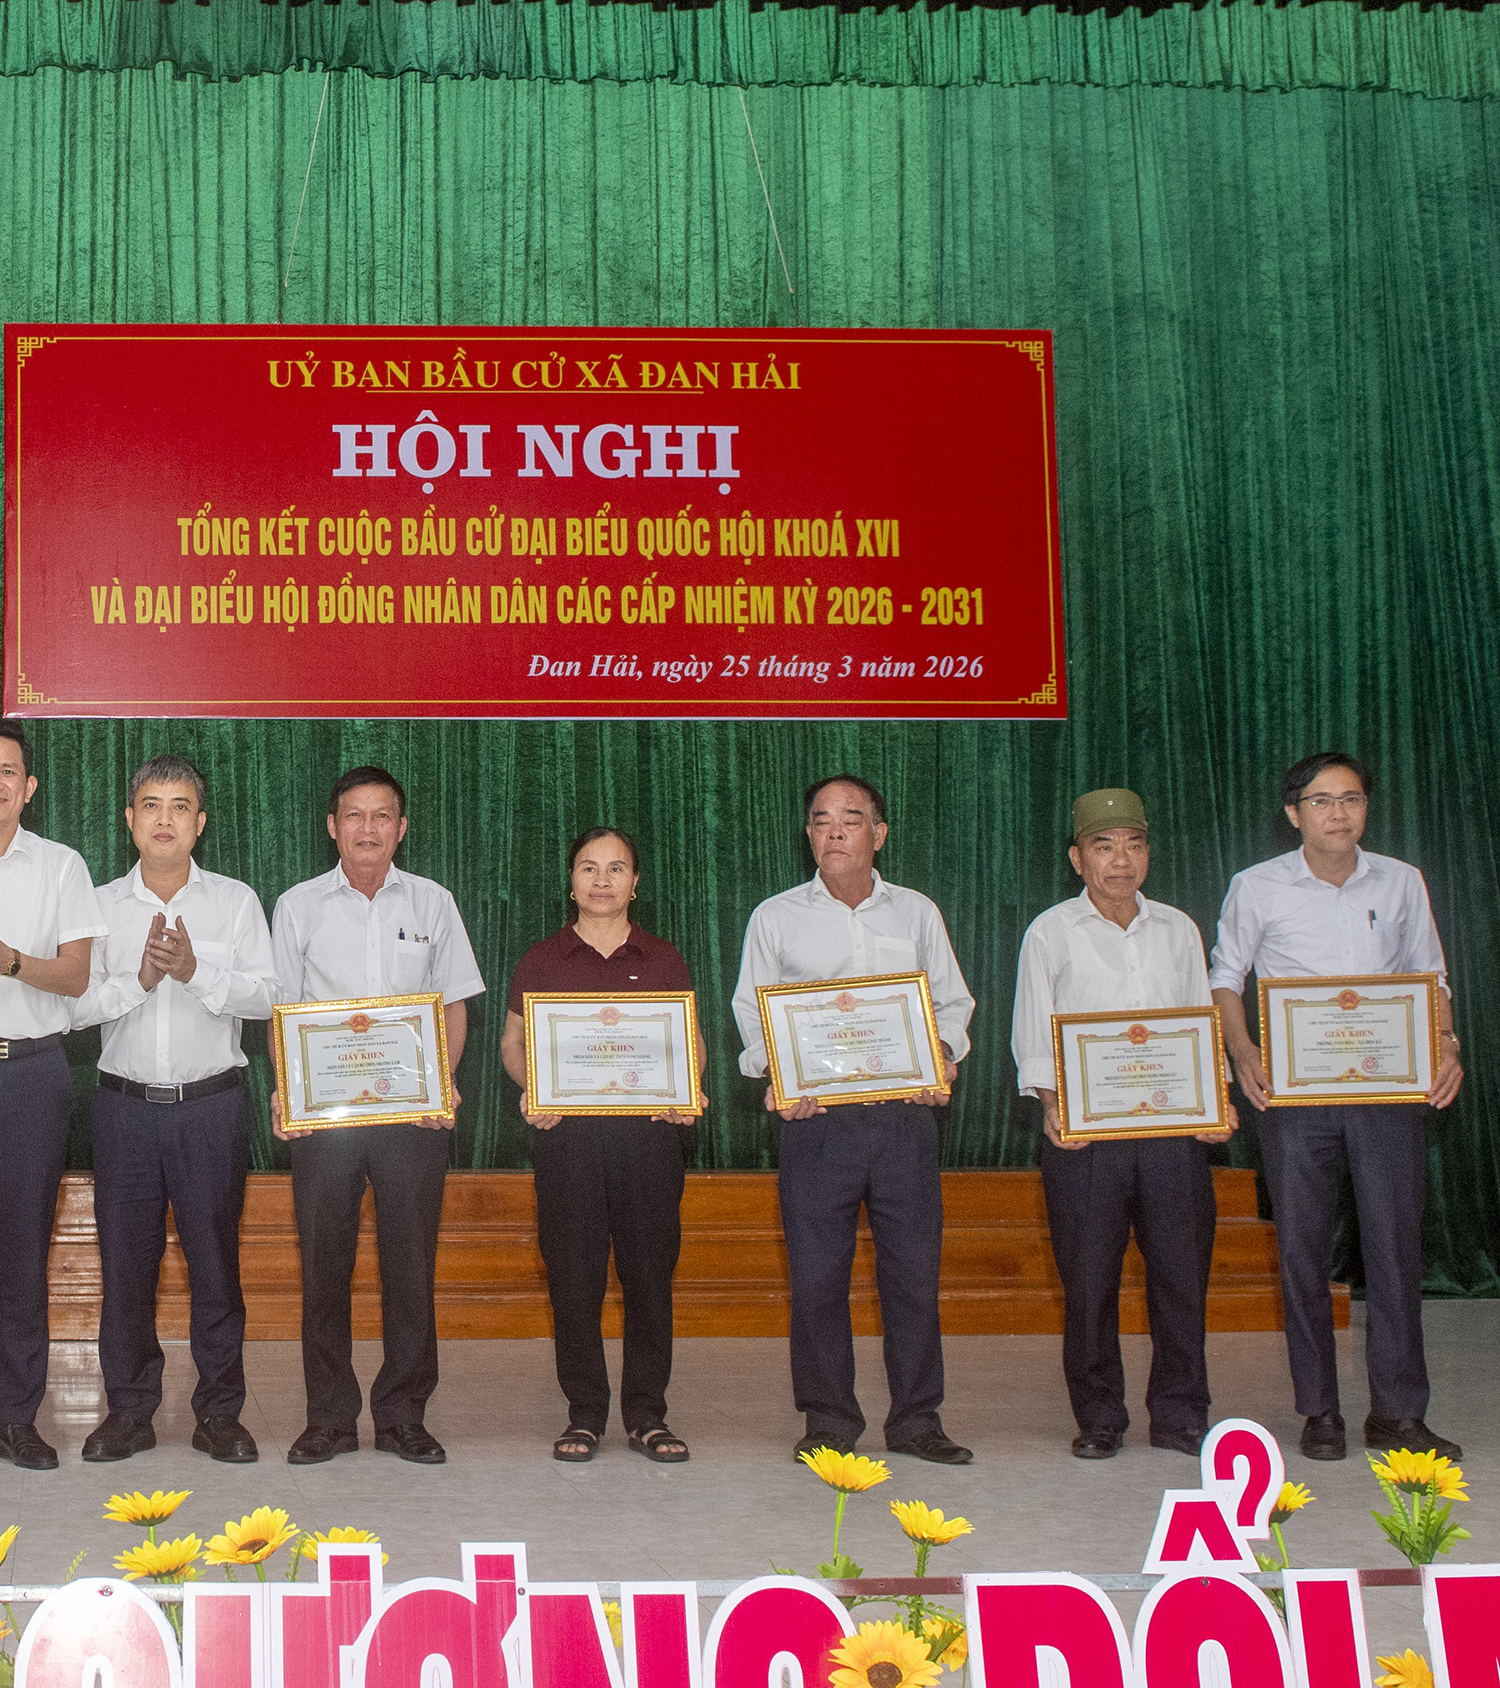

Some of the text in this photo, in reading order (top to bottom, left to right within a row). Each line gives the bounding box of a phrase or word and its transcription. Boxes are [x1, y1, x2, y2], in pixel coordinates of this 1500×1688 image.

[267, 346, 801, 390] UỶ BAN BẦU CỬ XÃ ĐAN HẢI
[331, 409, 741, 495] HỘI NGHỊ
[176, 501, 900, 566] TỔNG KẾT CUỘC BẦU CỬ ĐẠI BIỂU QUỐC HỘI KHOÁ XVI
[89, 568, 983, 635] VÀ ĐẠI BIỂU HỘI ĐỒNG NHÂN DÂN CÁC CẤP NHIỆM KỲ 2026 - 2031
[526, 654, 984, 684] Đan Hải, ngày 25 tháng 3 năm 2026
[361, 1051, 385, 1059] KHEN
[851, 1029, 875, 1038] KHEN
